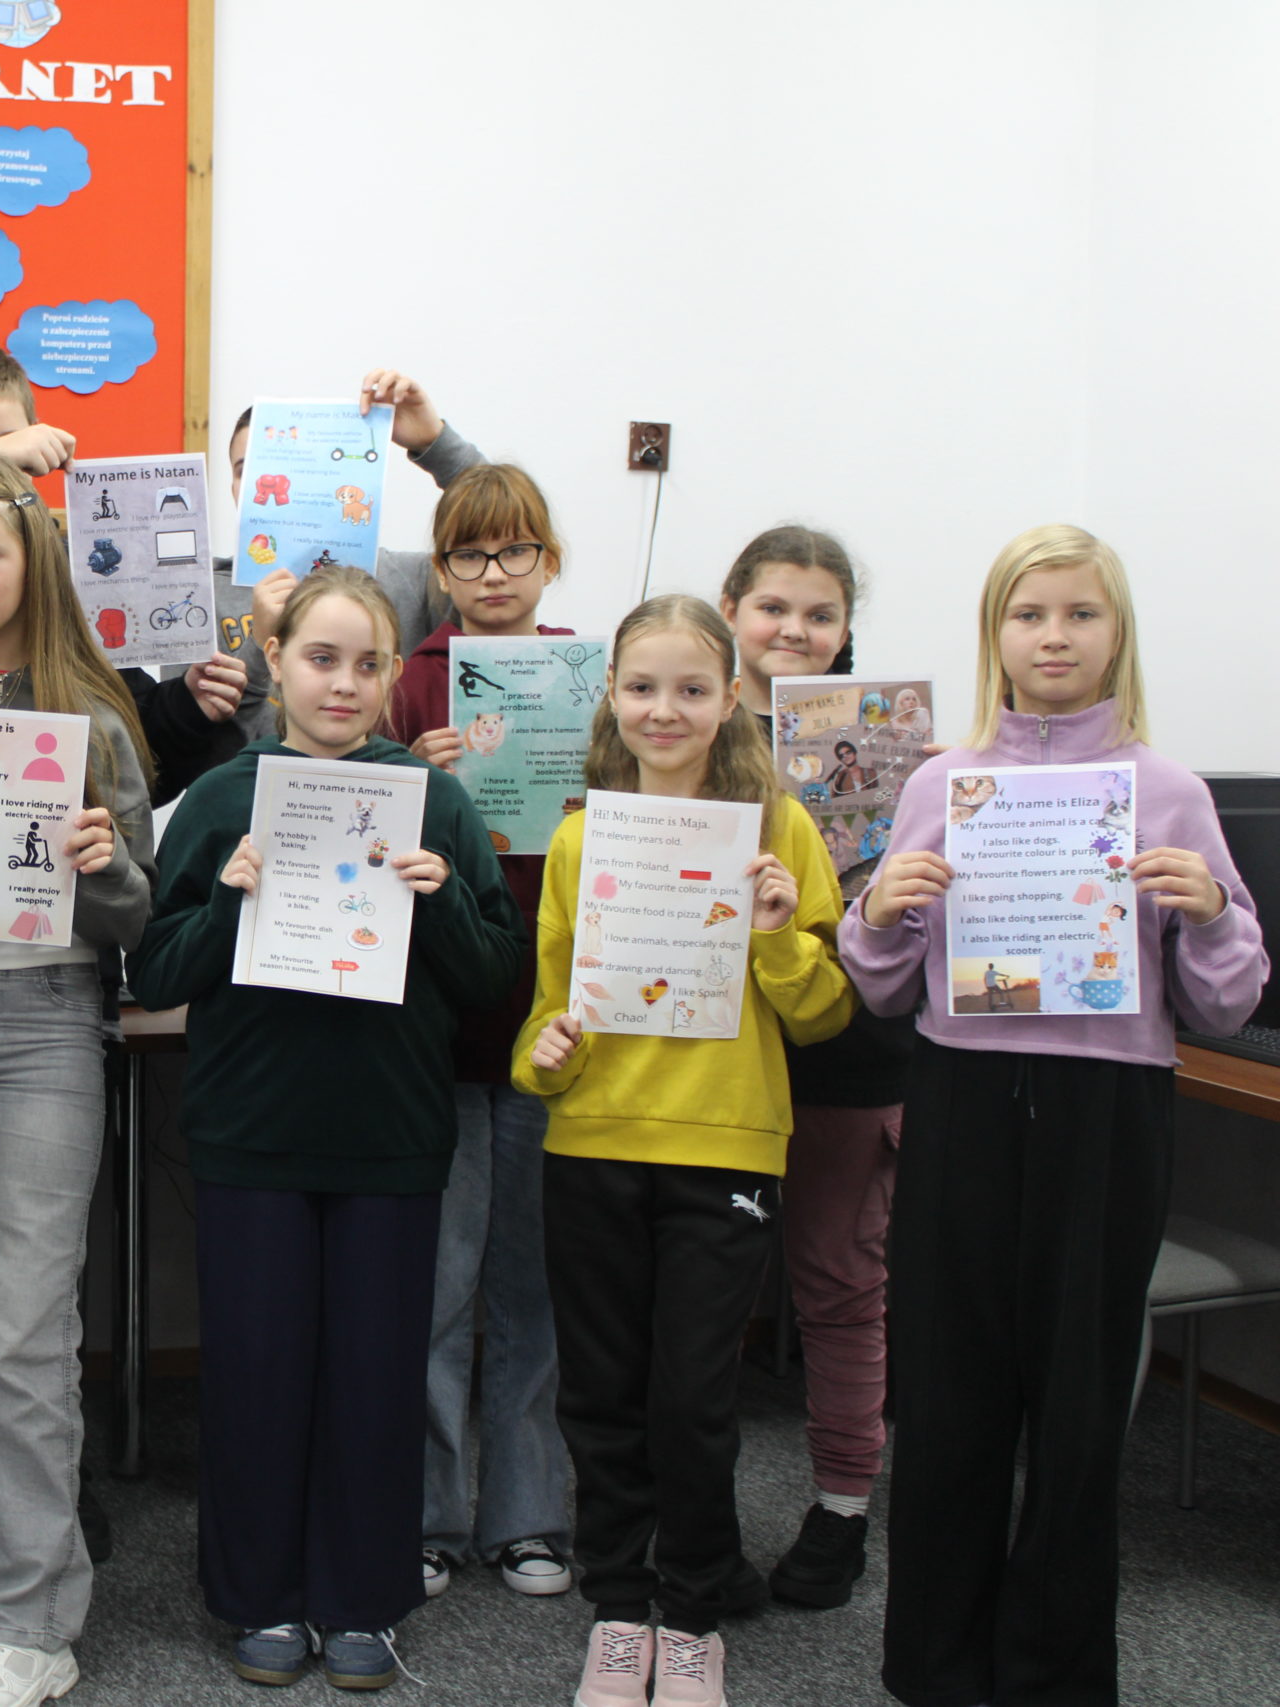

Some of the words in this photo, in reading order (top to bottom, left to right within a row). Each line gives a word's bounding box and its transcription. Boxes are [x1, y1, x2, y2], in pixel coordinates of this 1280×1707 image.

[75, 472, 95, 486] My
[99, 471, 136, 482] name
[140, 467, 151, 479] is
[154, 467, 200, 478] Natan.
[5, 722, 14, 733] is
[288, 780, 300, 790] Hi,
[303, 783, 318, 792] my
[319, 784, 346, 792] name
[347, 785, 356, 794] is
[356, 786, 392, 797] Amelka
[5, 799, 24, 807] love
[26, 799, 54, 812] riding
[994, 800, 1013, 812] My
[1016, 800, 1053, 809] name
[1056, 798, 1067, 807] is
[1070, 796, 1100, 807] Eliza
[4, 811, 34, 820] electric
[35, 813, 66, 822] scooter.
[592, 808, 610, 820] Hi!
[612, 810, 630, 824] My
[632, 815, 665, 825] name
[667, 818, 676, 826] is
[962, 894, 966, 902] I
[968, 894, 986, 902] like
[987, 892, 1015, 903] going
[672, 987, 676, 996] I
[678, 987, 696, 997] like
[697, 988, 728, 1000] Spain!
[613, 1011, 647, 1023] Chao!
